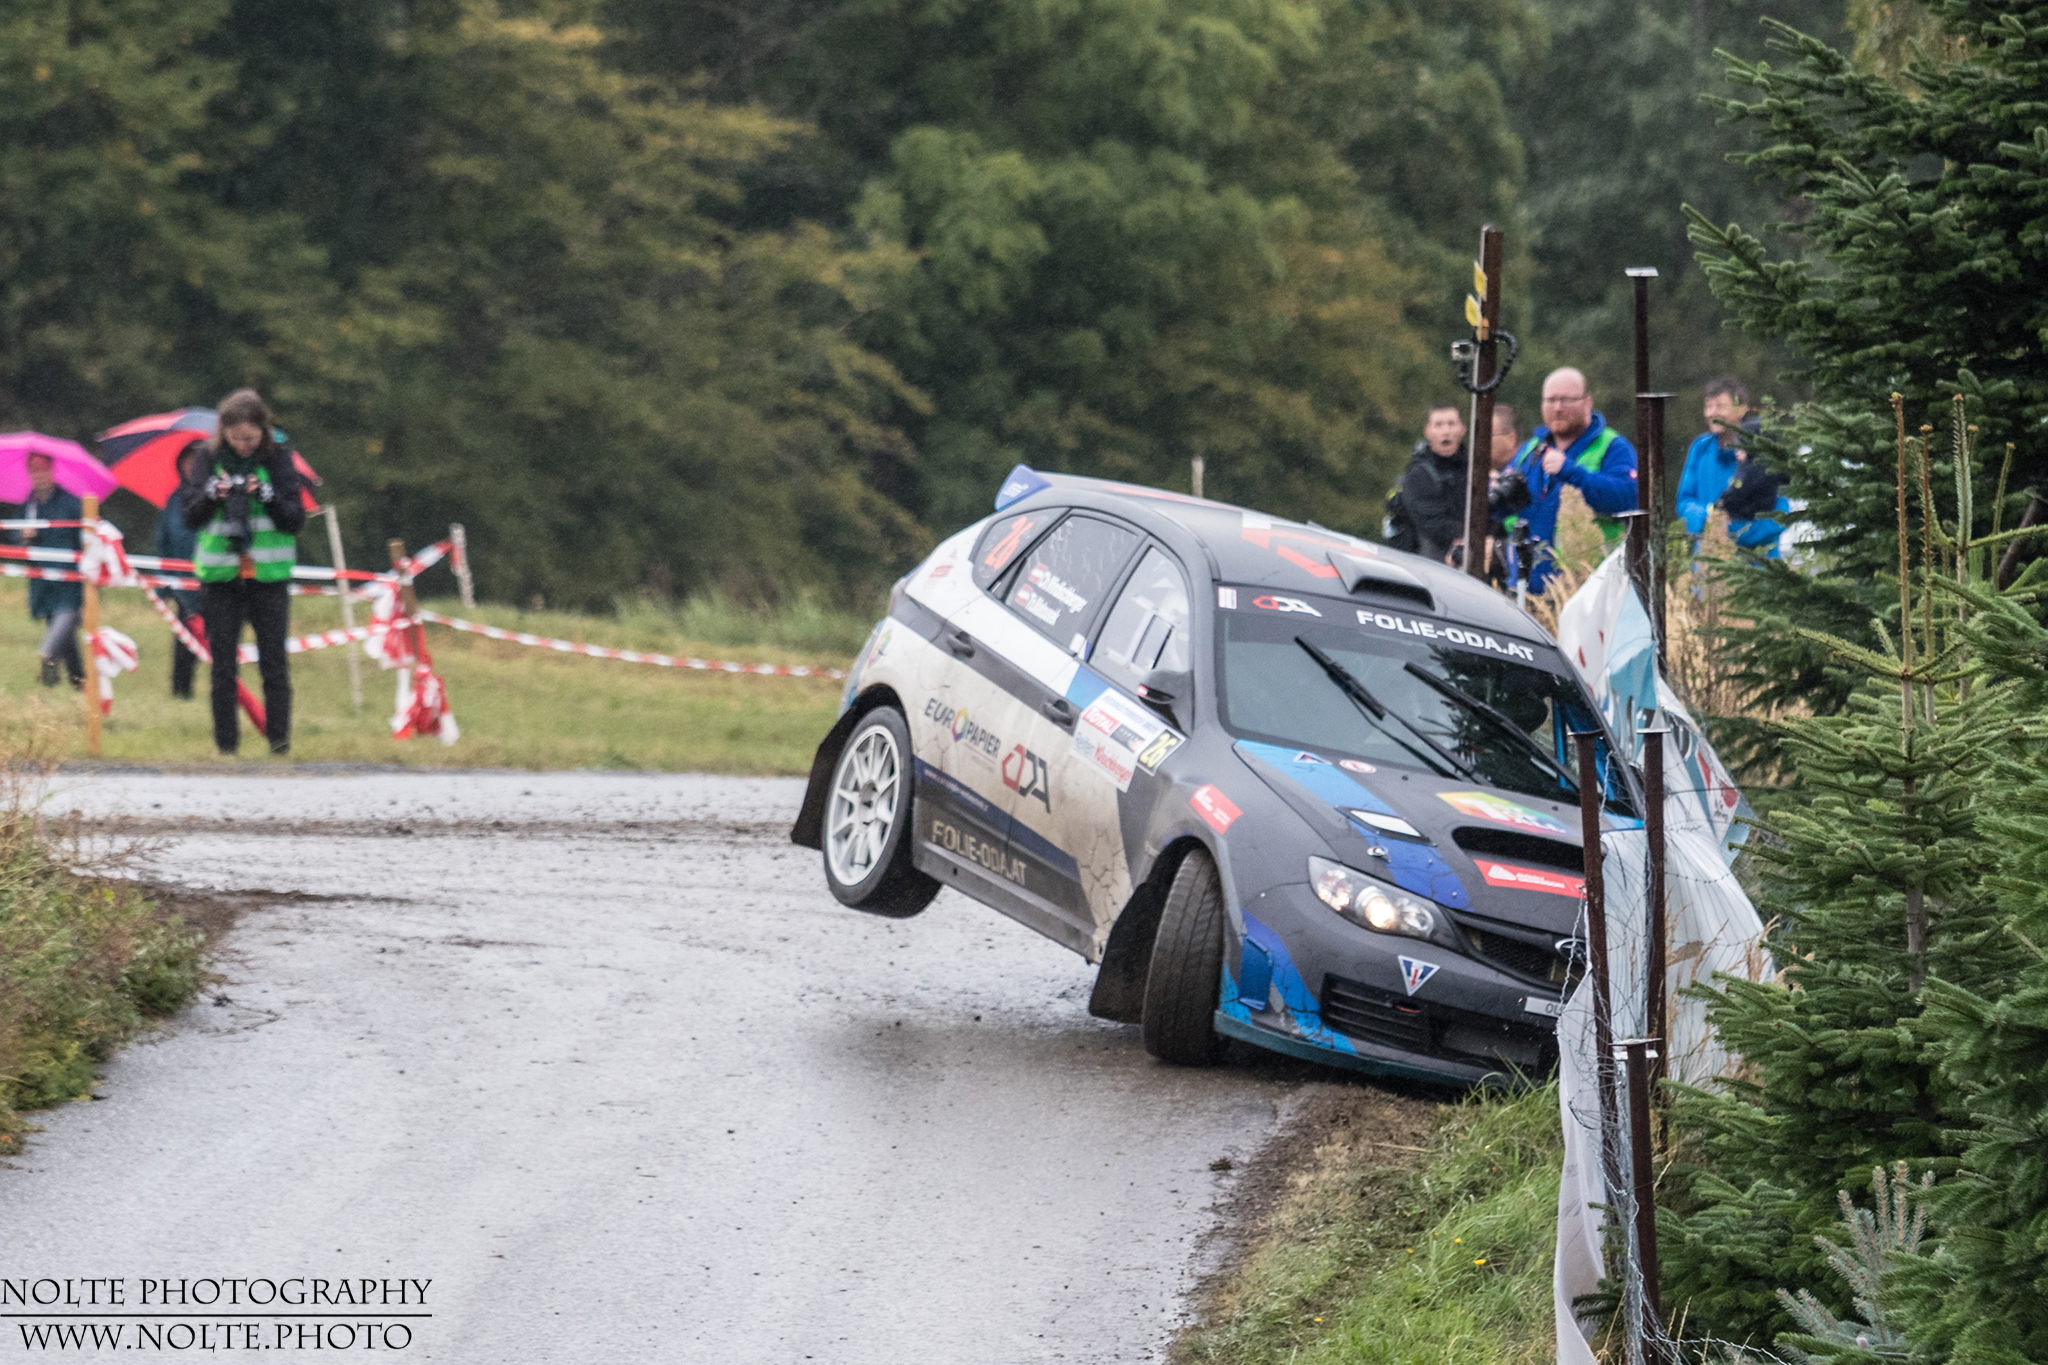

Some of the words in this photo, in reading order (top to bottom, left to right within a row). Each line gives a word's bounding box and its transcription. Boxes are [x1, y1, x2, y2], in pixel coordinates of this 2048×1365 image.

[1356, 610, 1534, 662] FOLIE-ODA.AT
[924, 697, 1001, 758] EUROPAPIER
[1084, 708, 1115, 735] TOTAL
[1139, 732, 1178, 768] 26
[931, 820, 1027, 886] FOLIE-ODA.AT
